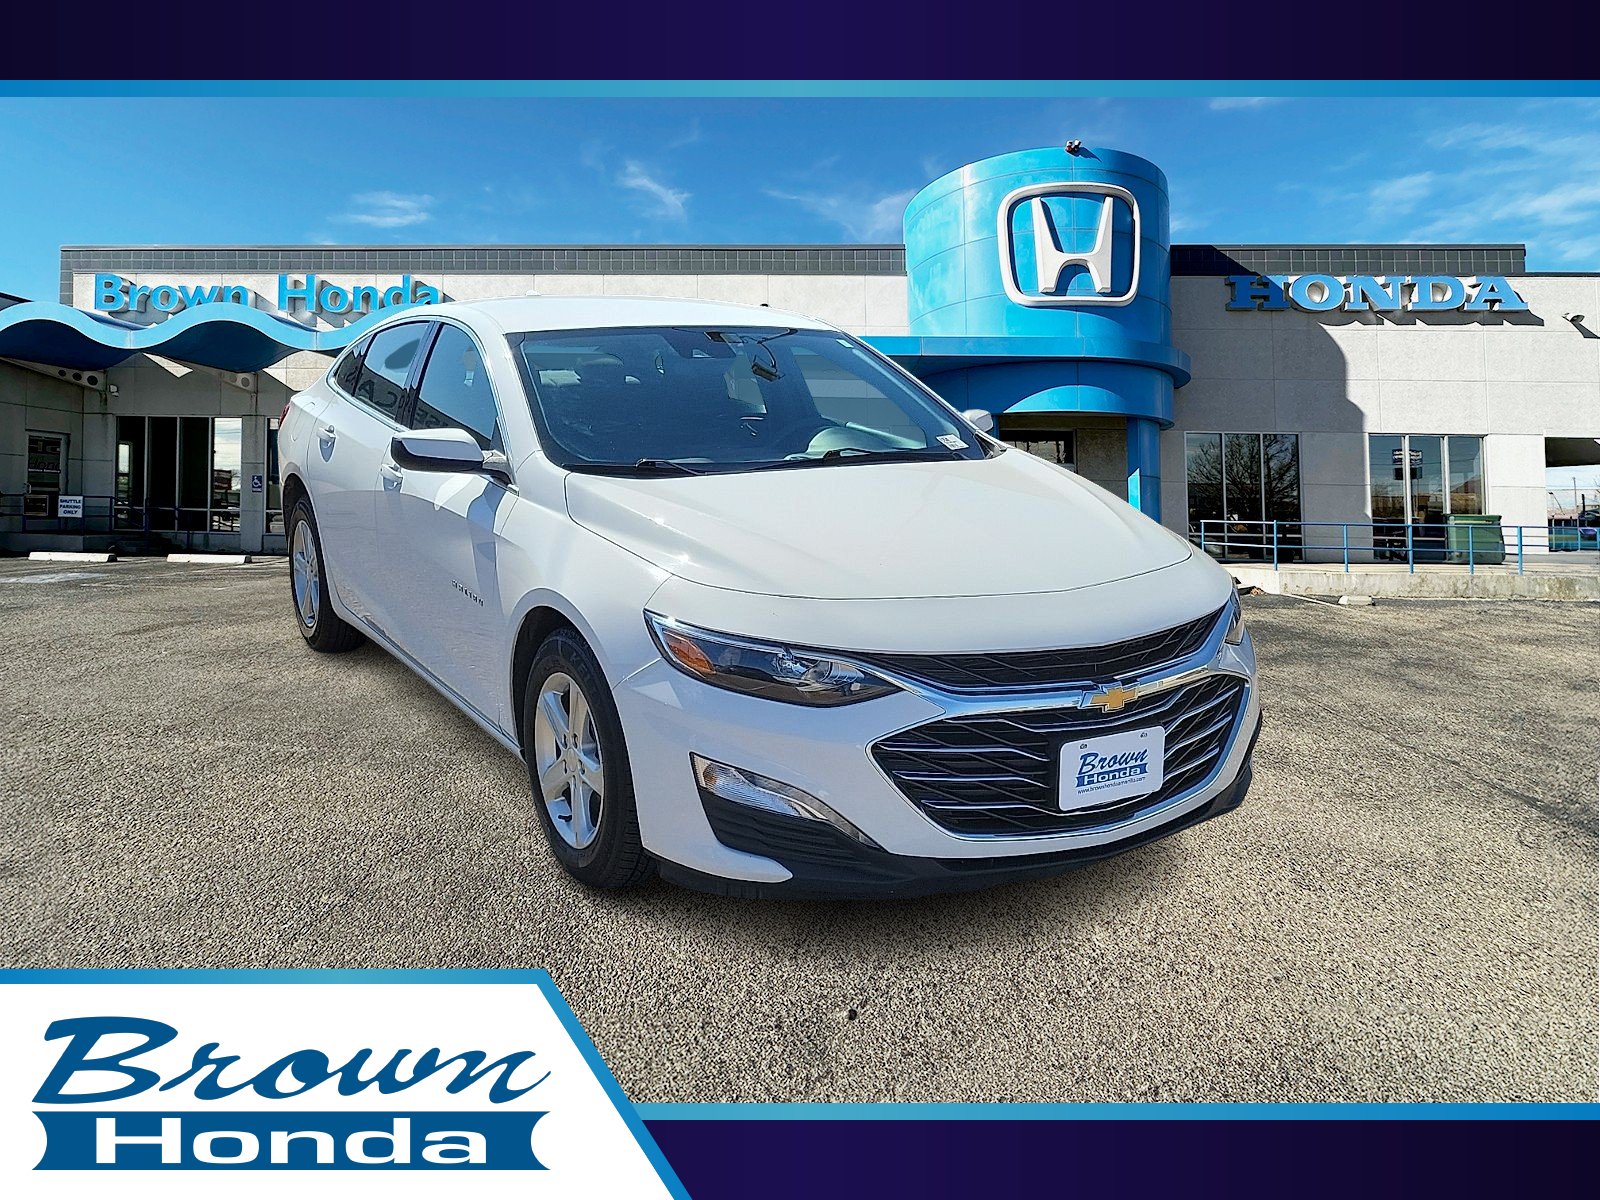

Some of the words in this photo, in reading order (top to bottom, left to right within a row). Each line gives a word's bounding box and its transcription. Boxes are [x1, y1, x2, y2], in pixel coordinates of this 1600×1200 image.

[94, 273, 251, 311] Brown
[278, 273, 438, 312] Honda
[1227, 274, 1528, 311] HONDA
[1078, 749, 1148, 775] Brown
[1084, 767, 1141, 785] Honda
